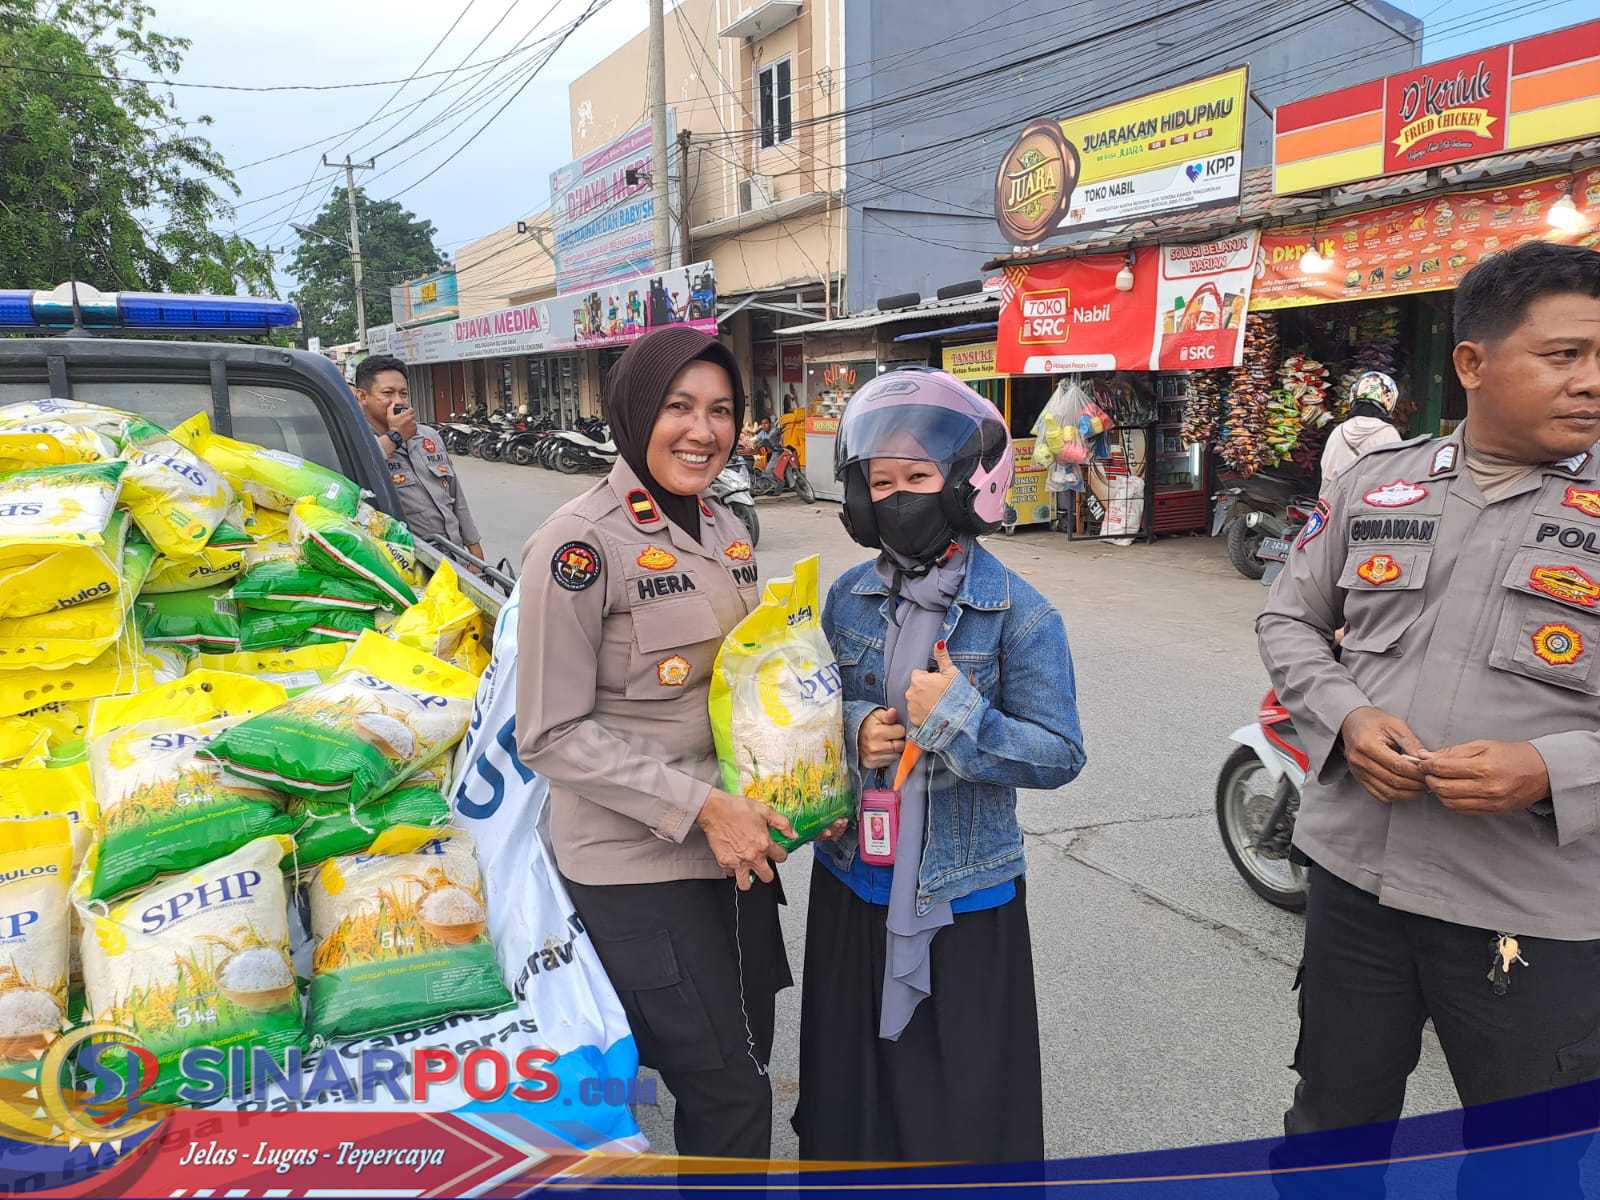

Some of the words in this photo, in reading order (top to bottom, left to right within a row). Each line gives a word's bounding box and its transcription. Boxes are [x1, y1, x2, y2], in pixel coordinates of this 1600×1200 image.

[1082, 118, 1157, 153] JUARAKAN
[1160, 97, 1234, 130] HIDUPMU
[1404, 118, 1434, 143] FRIED
[1437, 111, 1481, 129] CHICKEN
[1206, 155, 1235, 177] KPP
[1008, 164, 1057, 206] JUARA
[1084, 186, 1106, 203] TOKO
[1108, 180, 1135, 197] NABIL
[1170, 246, 1201, 261] SOLUSI
[1190, 255, 1227, 273] HARIAN
[1028, 300, 1063, 315] TOKO
[1072, 303, 1111, 324] Nabil
[455, 317, 492, 341] D'JAYA
[494, 306, 540, 335] MEDIA
[1351, 519, 1435, 541] GUNAWAN
[58, 581, 112, 609] bulog
[637, 573, 696, 600] HERA
[176, 792, 191, 808] 5
[141, 870, 262, 935] SPHP
[381, 931, 396, 950] 5
[176, 1008, 193, 1027] 5
[194, 1008, 218, 1025] kg
